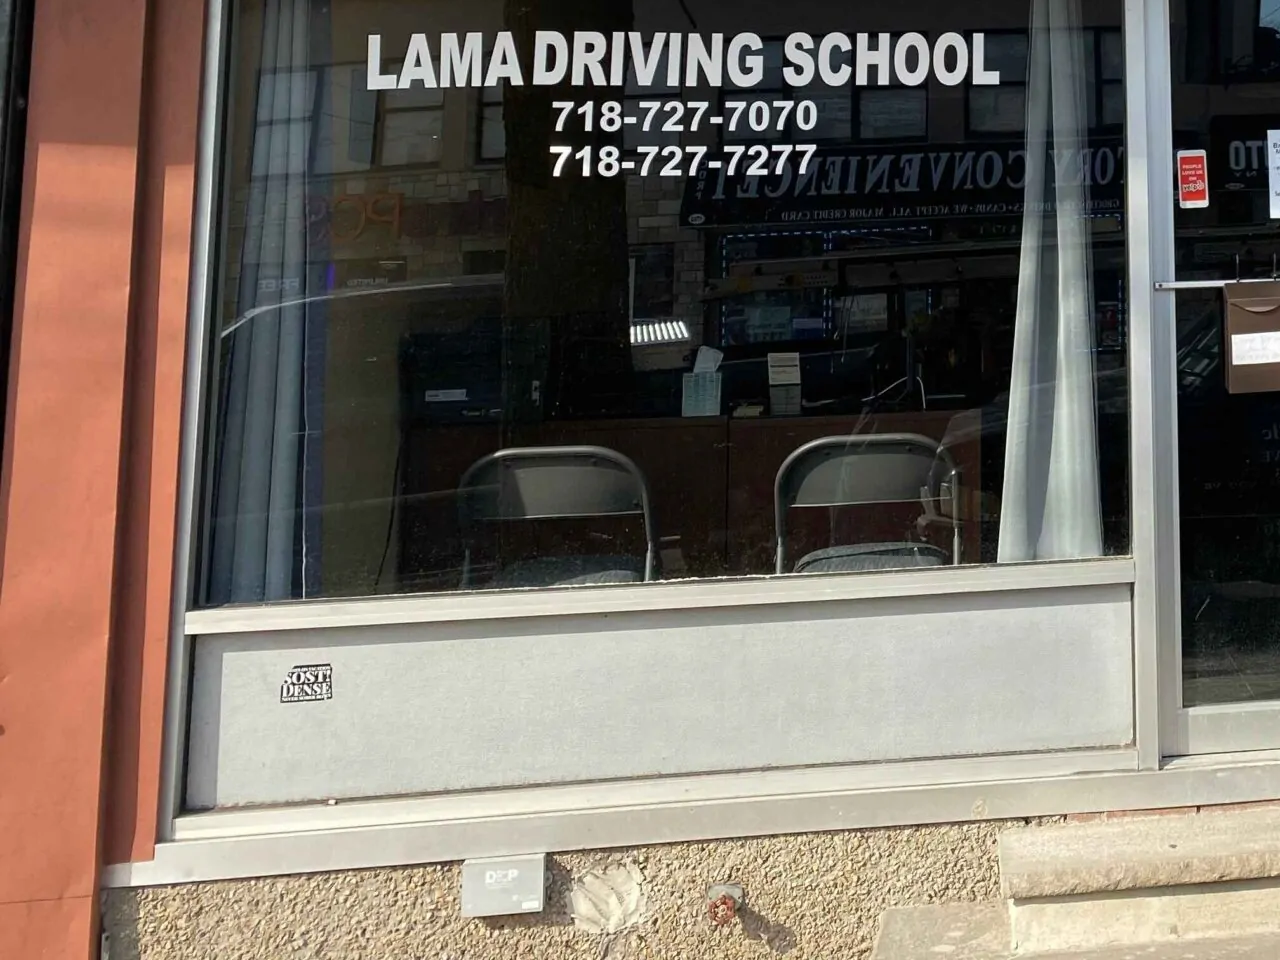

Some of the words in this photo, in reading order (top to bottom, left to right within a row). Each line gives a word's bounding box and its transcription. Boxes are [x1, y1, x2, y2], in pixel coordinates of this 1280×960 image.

[366, 31, 524, 90] LAMA
[532, 30, 764, 88] DRIVING
[782, 31, 1000, 87] SCHOOL
[552, 100, 818, 132] 718-727-7070
[549, 144, 817, 177] 718-727-7277
[282, 683, 331, 697] DENSE
